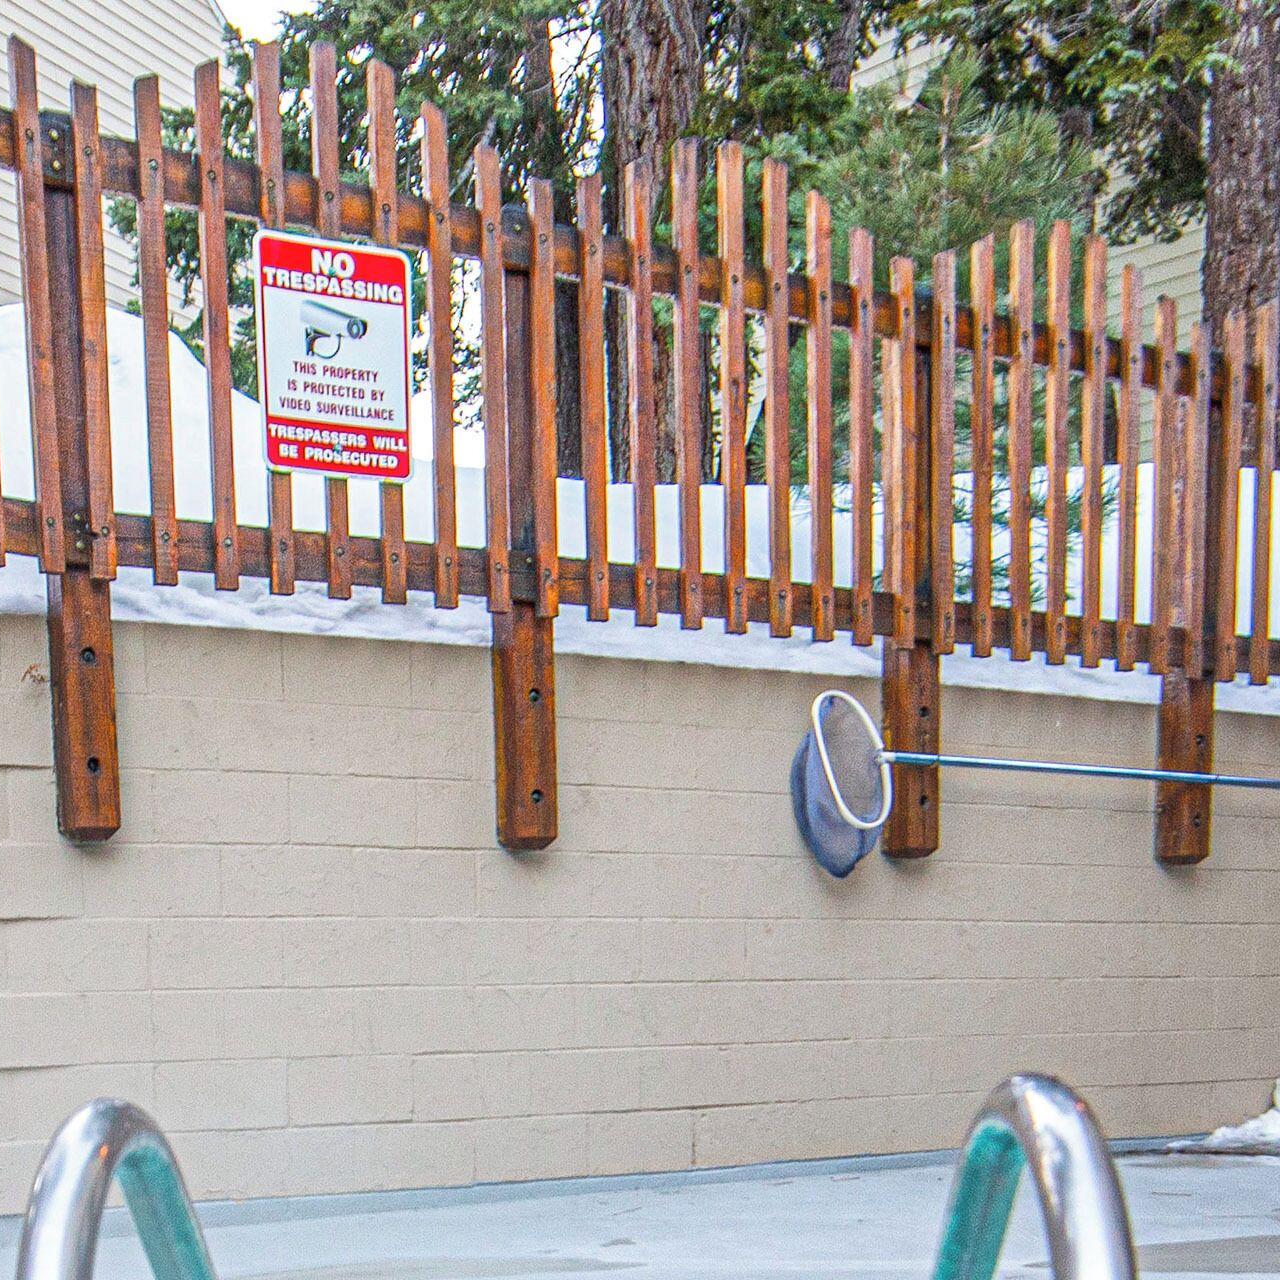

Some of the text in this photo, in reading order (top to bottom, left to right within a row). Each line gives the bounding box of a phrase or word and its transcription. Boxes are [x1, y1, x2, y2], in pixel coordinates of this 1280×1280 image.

[310, 248, 356, 279] NO
[262, 265, 404, 304] TRESPASSING
[292, 360, 379, 383] THIS PROPERTY
[287, 378, 385, 402] IS PROTECTED BY
[279, 396, 395, 421] VIDEO SURVEILLANCE
[268, 423, 407, 452] TRESPASSERS WILL
[279, 443, 399, 470] BE PROSECUTED
